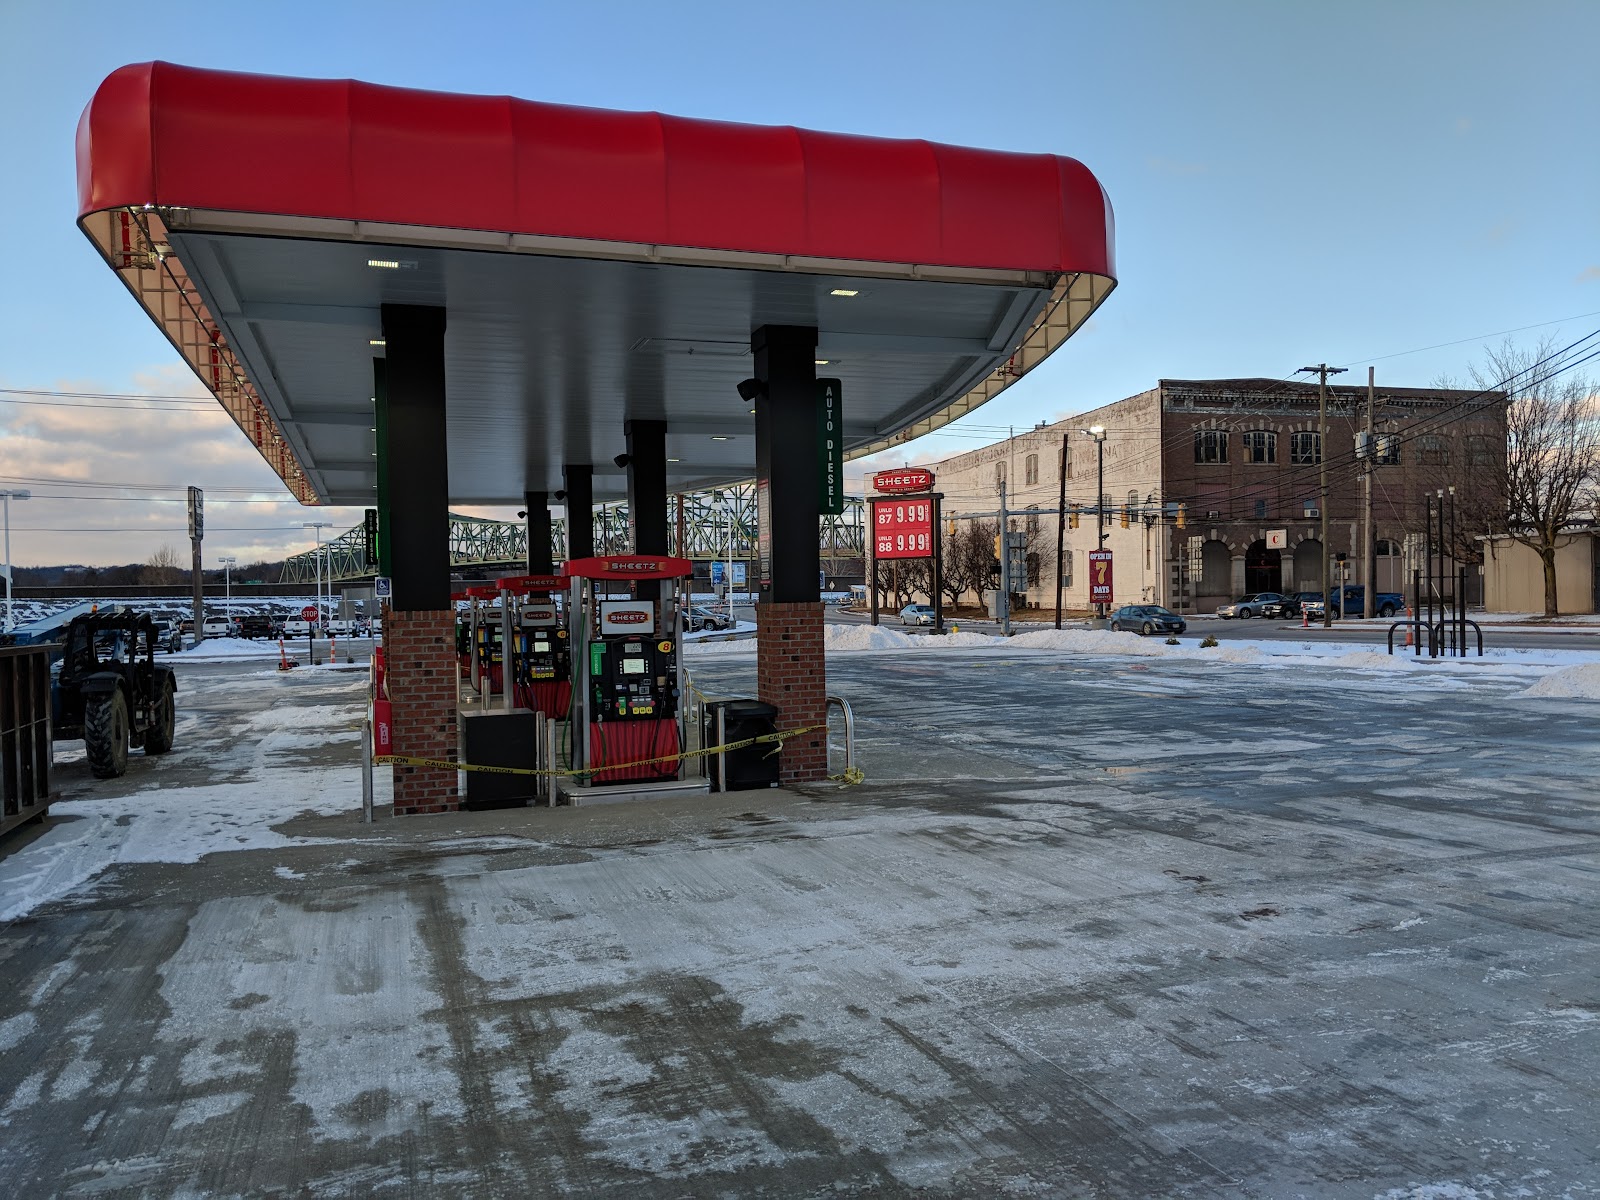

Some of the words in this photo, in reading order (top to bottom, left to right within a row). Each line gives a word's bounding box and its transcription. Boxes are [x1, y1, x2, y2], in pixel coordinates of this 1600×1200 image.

[826, 440, 835, 507] DIESEL
[877, 475, 926, 487] SHEETZ
[878, 514, 893, 525] 87
[896, 504, 925, 523] 9.99
[878, 542, 893, 552] 88
[897, 533, 925, 551] 9.99
[611, 562, 656, 570] SHEETZ
[1095, 561, 1107, 585] 7
[1093, 585, 1110, 594] DAYS
[302, 610, 318, 618] STOP
[663, 643, 670, 651] 8
[378, 756, 409, 764] CAUTION
[424, 760, 461, 769] CAUTION
[477, 766, 514, 774] CAUTION
[630, 758, 664, 768] CAUTION
[678, 749, 712, 760] CAUTION
[724, 739, 757, 751] CAUTION
[767, 730, 797, 741] CAUTION
